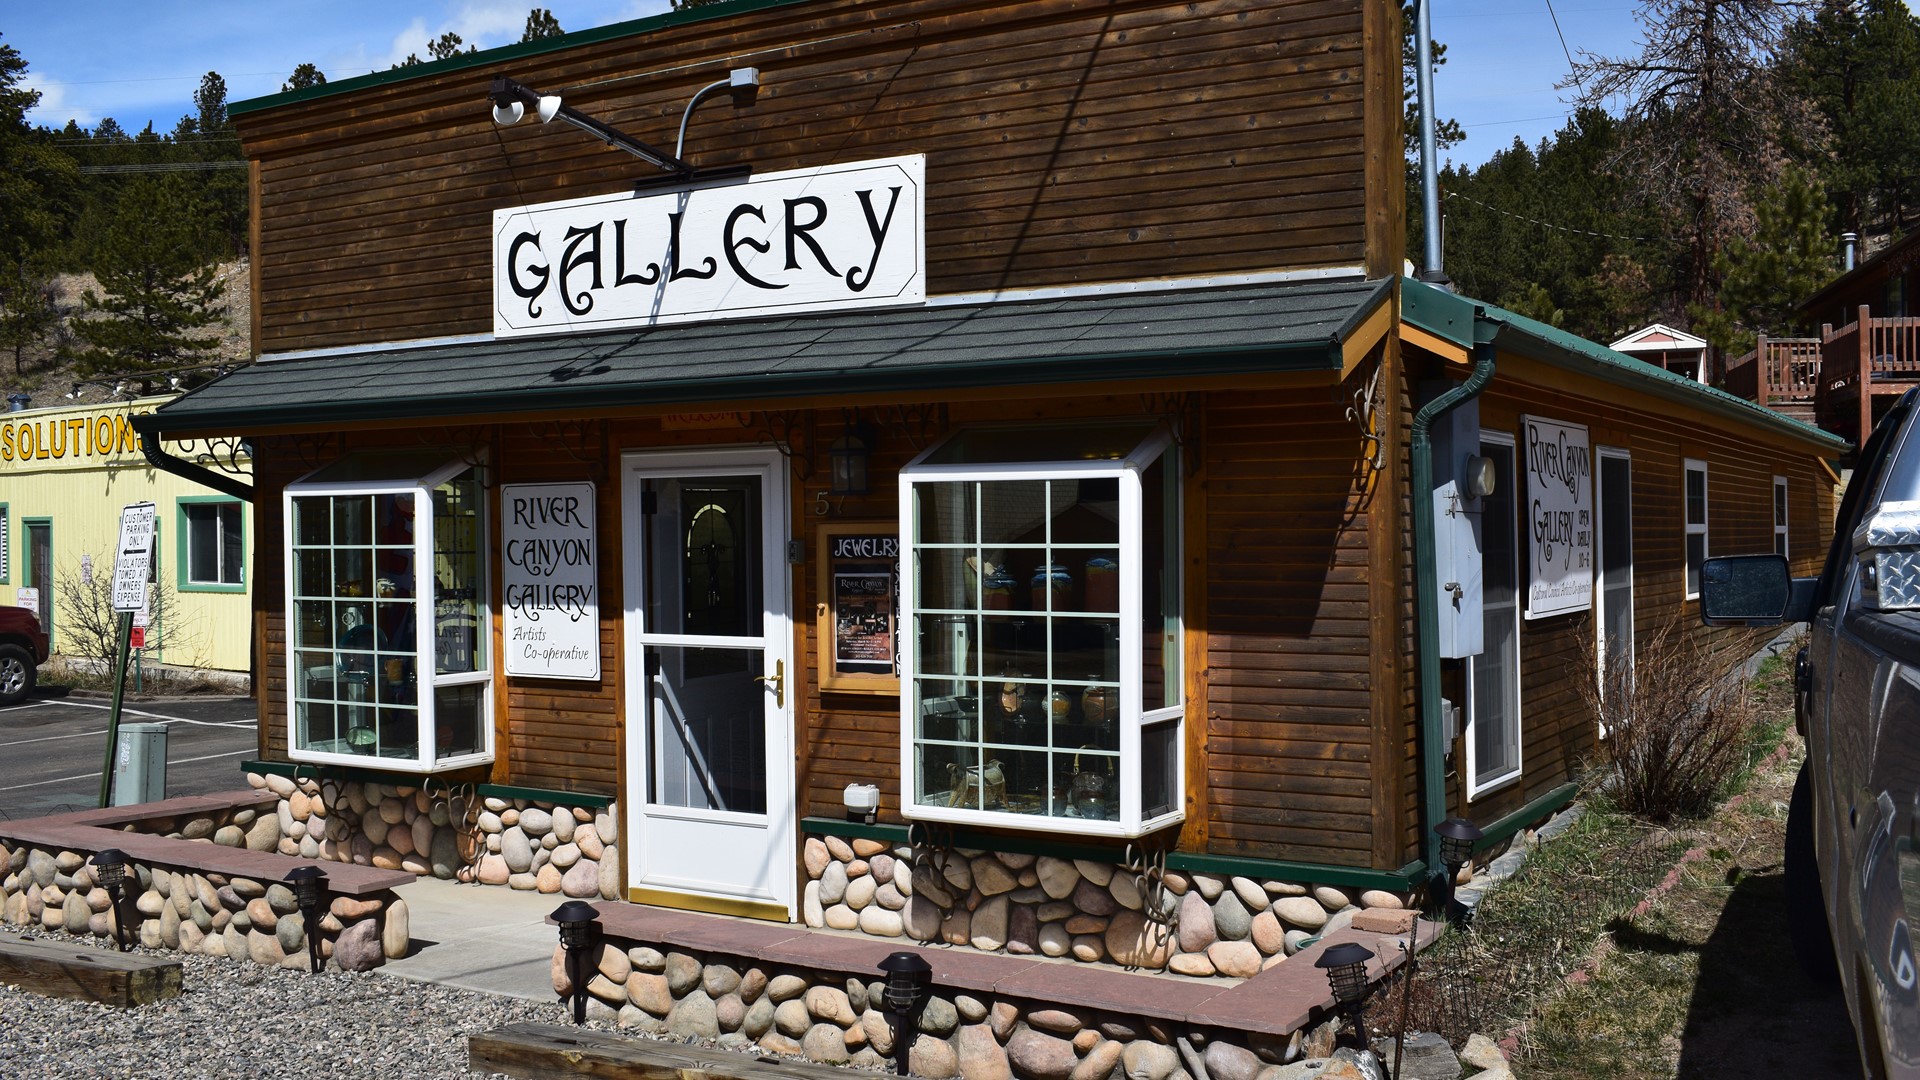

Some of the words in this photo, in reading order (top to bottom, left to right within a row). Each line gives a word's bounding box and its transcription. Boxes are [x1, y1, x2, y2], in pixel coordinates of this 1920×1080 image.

[507, 186, 903, 319] GALLERY
[1, 412, 151, 461] SOLUTION
[1529, 424, 1563, 489] RIVER
[1559, 430, 1590, 504] CANYON
[125, 511, 153, 525] CUSTOMER
[513, 496, 589, 529] RIVER
[1578, 509, 1589, 526] OPEN
[126, 524, 150, 535] PARKING
[1533, 498, 1575, 575] GALLERY
[128, 535, 145, 547] ONLY
[834, 538, 899, 558] JEWELRY
[1577, 531, 1590, 549] DAILY
[118, 557, 148, 569] VIOLATORS
[506, 538, 592, 577] CANYON
[1578, 552, 1590, 569] 10-6
[118, 569, 136, 580] TOWED
[138, 568, 146, 579] AT
[118, 581, 141, 591] OWNERS
[116, 592, 141, 603] EXPENSE
[506, 584, 593, 623] GALLERY
[513, 626, 547, 641] Artists
[523, 643, 589, 668] Co-operative
